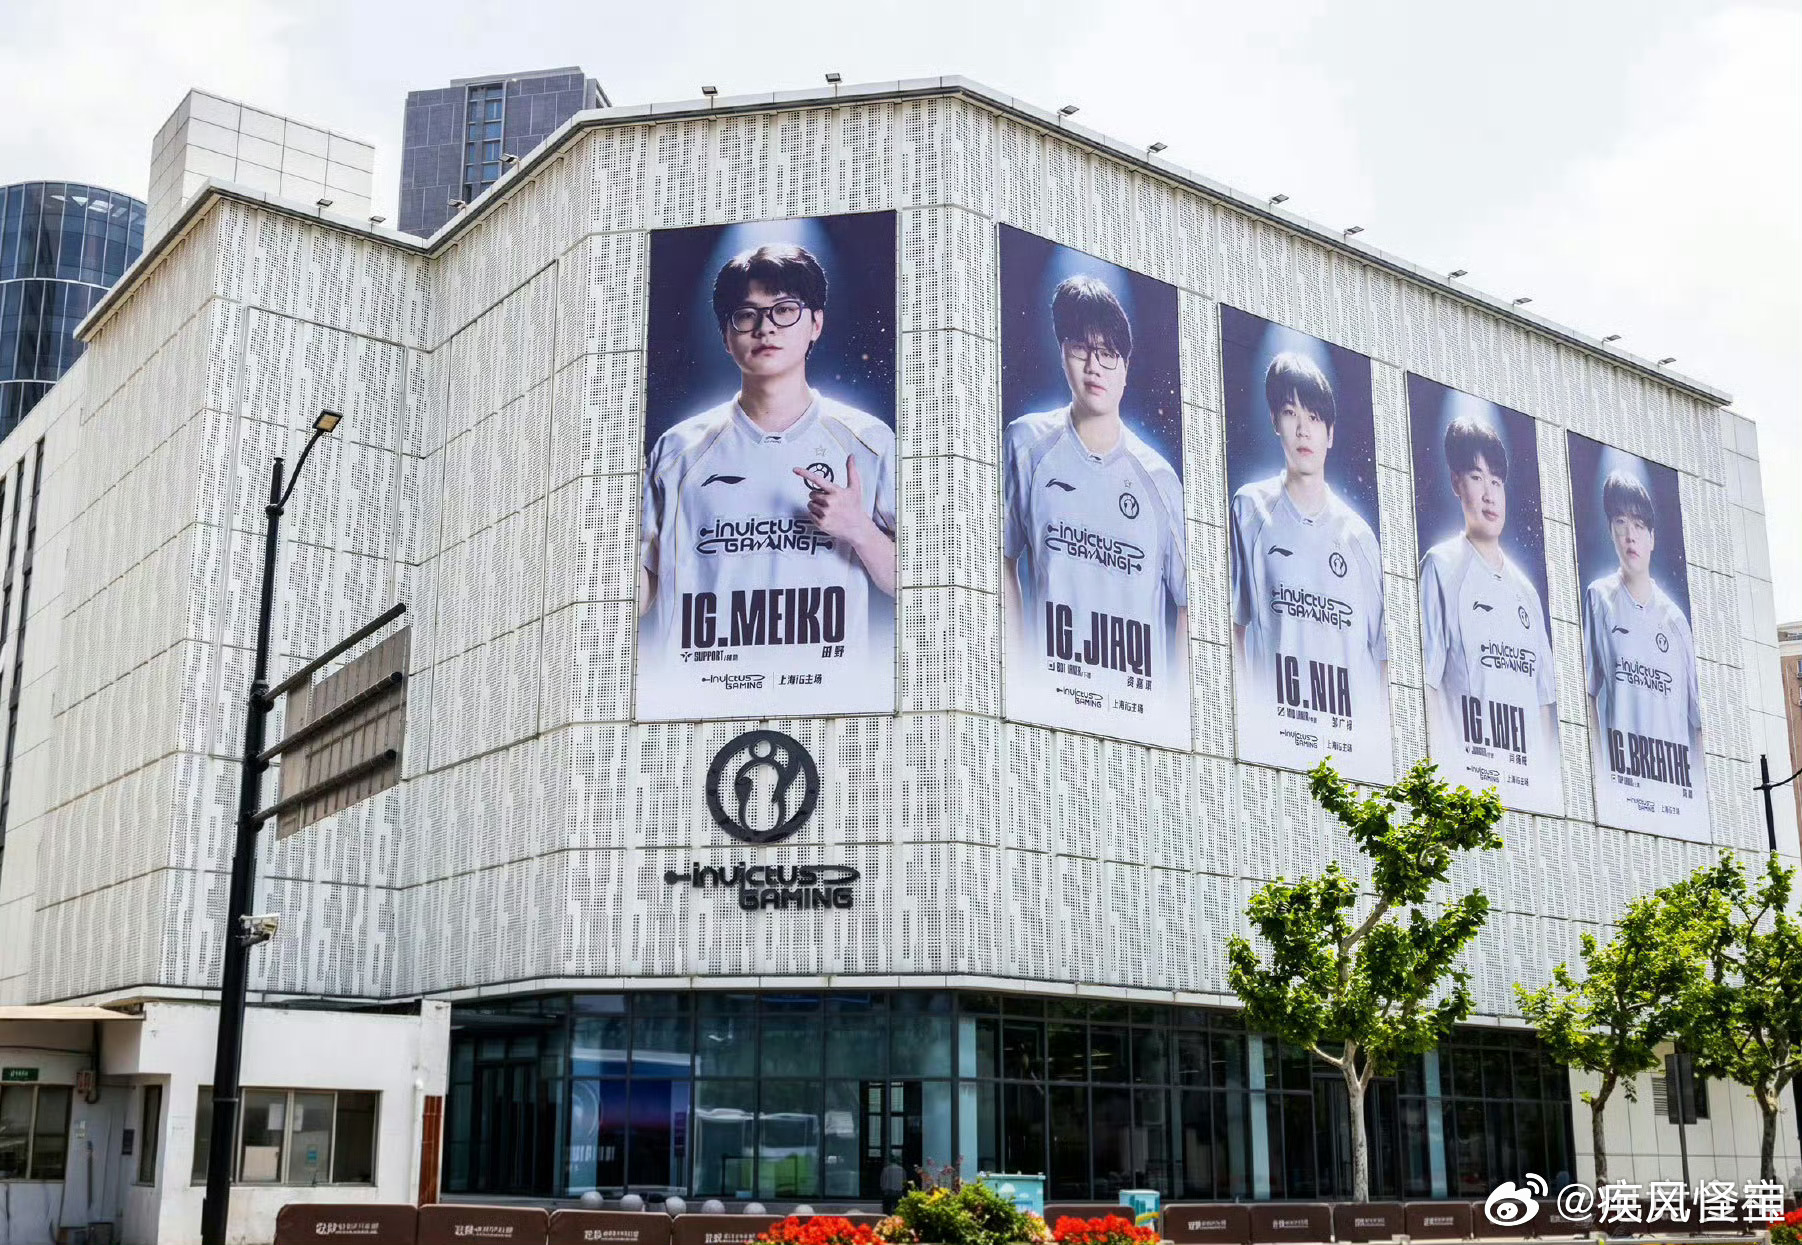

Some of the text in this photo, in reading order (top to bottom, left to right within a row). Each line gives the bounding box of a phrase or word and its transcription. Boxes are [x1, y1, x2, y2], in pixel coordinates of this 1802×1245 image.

[681, 586, 846, 649] IG.MEIKO
[694, 650, 724, 662] SUPPORT
[822, 645, 845, 658] 田野
[1046, 600, 1151, 678] IG.JIAQI
[725, 681, 763, 690] GAMING
[778, 674, 823, 686] 上海iG主场
[1275, 653, 1352, 717] IG.NIA
[1461, 694, 1526, 754] IG.WEI
[1607, 727, 1692, 789] IG.BREATHE
[738, 887, 854, 911] GAMING
